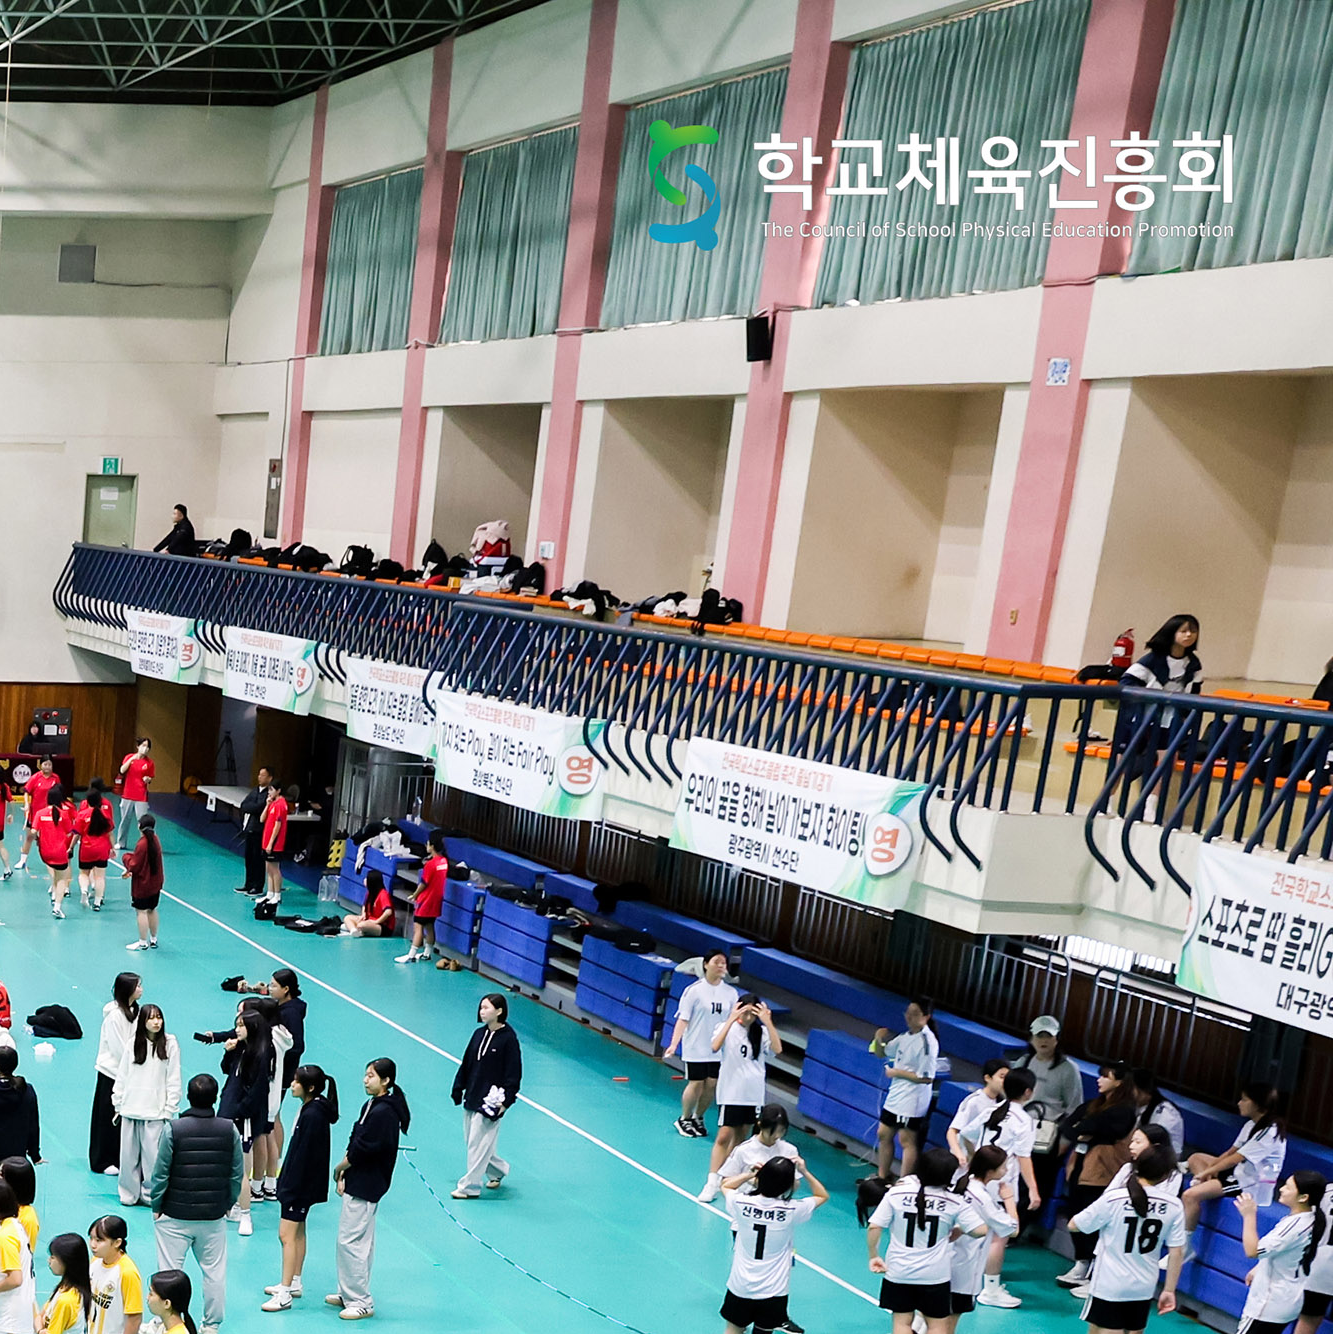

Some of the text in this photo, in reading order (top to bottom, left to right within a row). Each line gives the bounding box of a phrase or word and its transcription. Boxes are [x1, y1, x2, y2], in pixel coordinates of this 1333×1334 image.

[453, 724, 465, 754] 있는
[502, 735, 515, 766] 하는
[515, 741, 534, 772] Fair
[533, 746, 556, 786] Play
[566, 756, 594, 785] 영
[684, 772, 868, 858] 우리의 꿈을 향해 화이팅!
[728, 833, 800, 874] 광주광역시 선수단
[871, 825, 899, 863] 영
[1197, 895, 1287, 964] 스포츠로 땀
[710, 1002, 722, 1014] 14
[740, 1045, 749, 1058] 9
[742, 1206, 787, 1222] 신명여중
[753, 1224, 767, 1260] 1
[1124, 1217, 1163, 1255] 18
